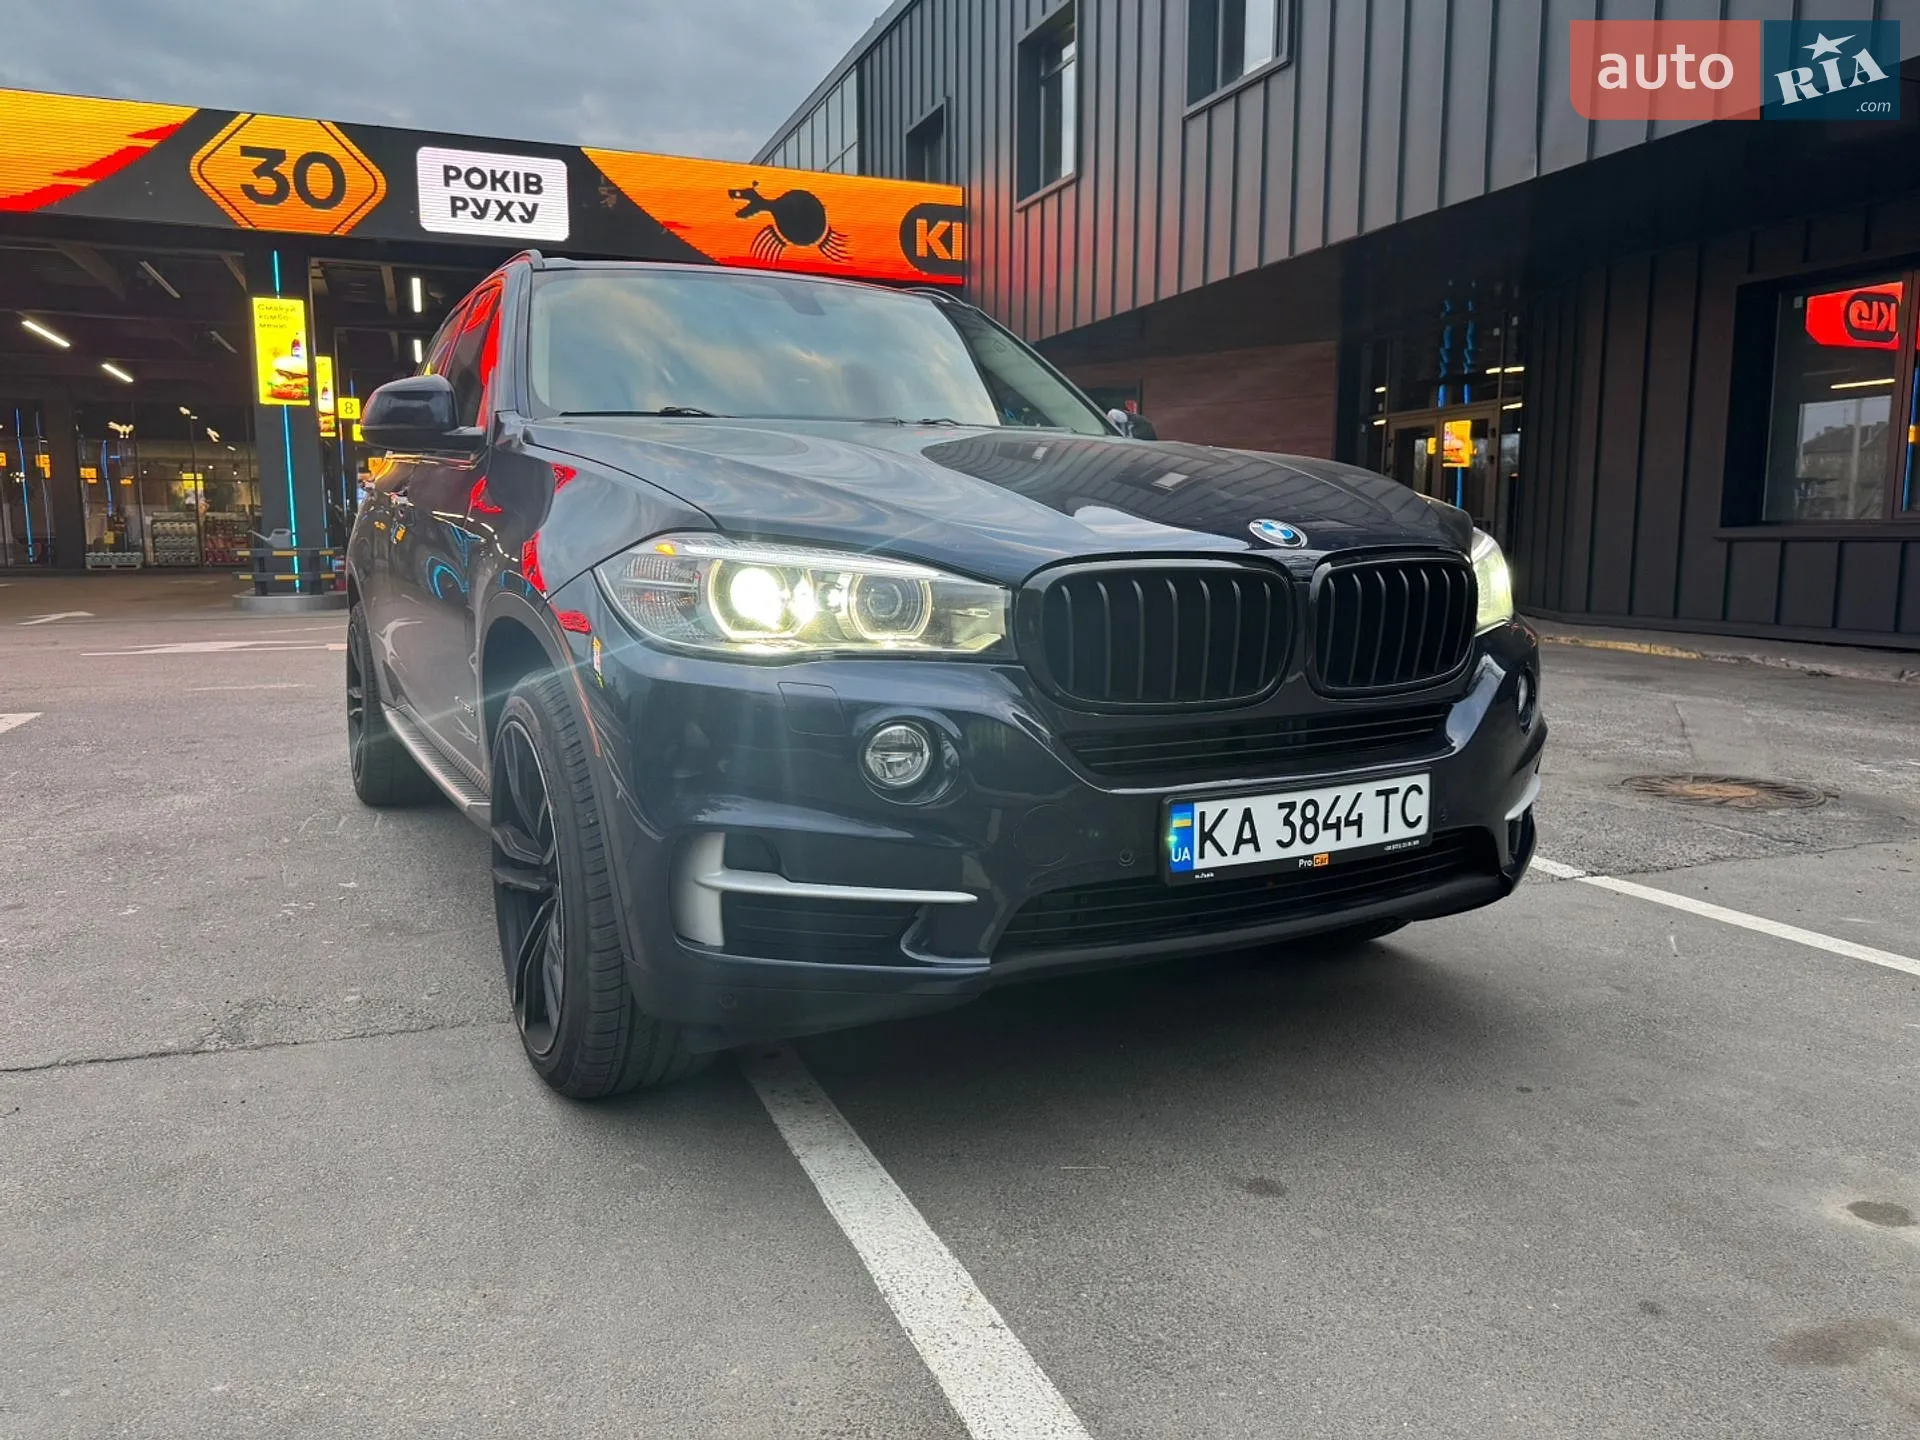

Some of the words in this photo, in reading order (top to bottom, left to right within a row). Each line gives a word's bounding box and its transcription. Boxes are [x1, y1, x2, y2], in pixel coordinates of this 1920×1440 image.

[239, 146, 346, 211] 30
[443, 164, 543, 195] РОКІВ
[450, 196, 539, 224] РУХУ
[344, 401, 354, 415] 8
[1172, 847, 1191, 863] UA
[1198, 807, 1261, 859] KA
[1276, 792, 1363, 849] 3844
[1375, 784, 1424, 834] TC
